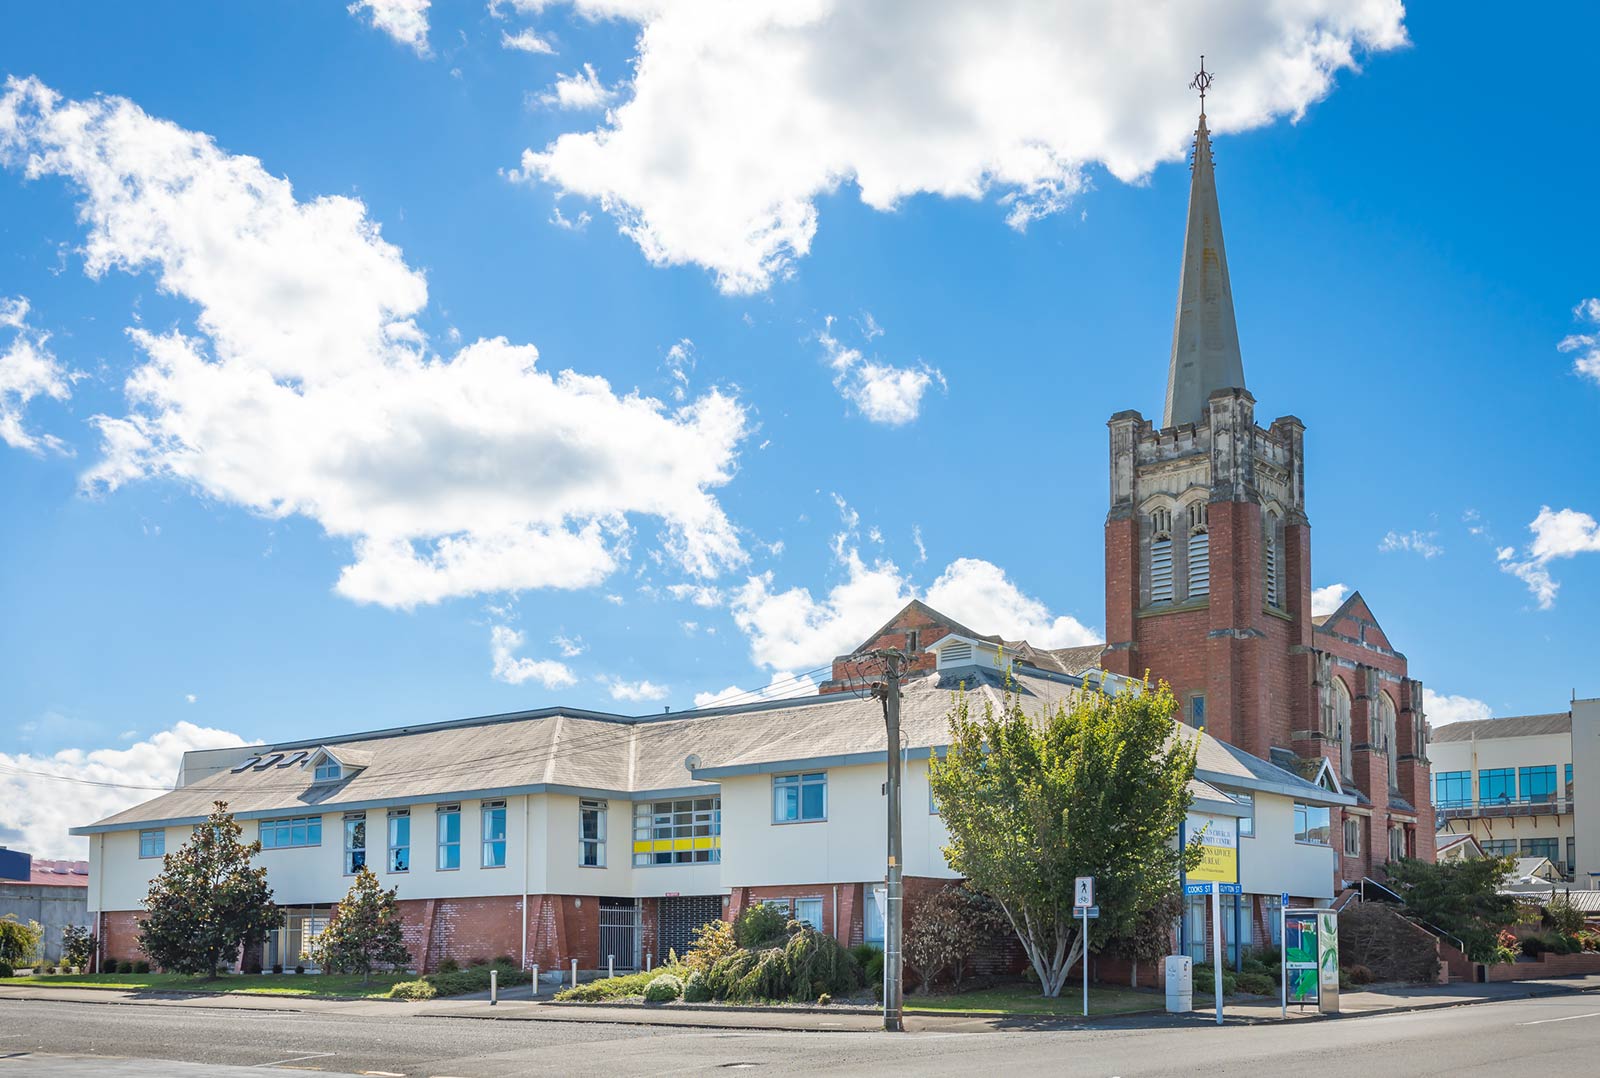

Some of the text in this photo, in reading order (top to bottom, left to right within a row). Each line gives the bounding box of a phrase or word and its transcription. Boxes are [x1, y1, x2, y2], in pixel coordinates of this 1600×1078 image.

[1214, 848, 1232, 858] ADVICE
[1187, 885, 1211, 894] COOKS ST
[1235, 885, 1241, 893] ST
